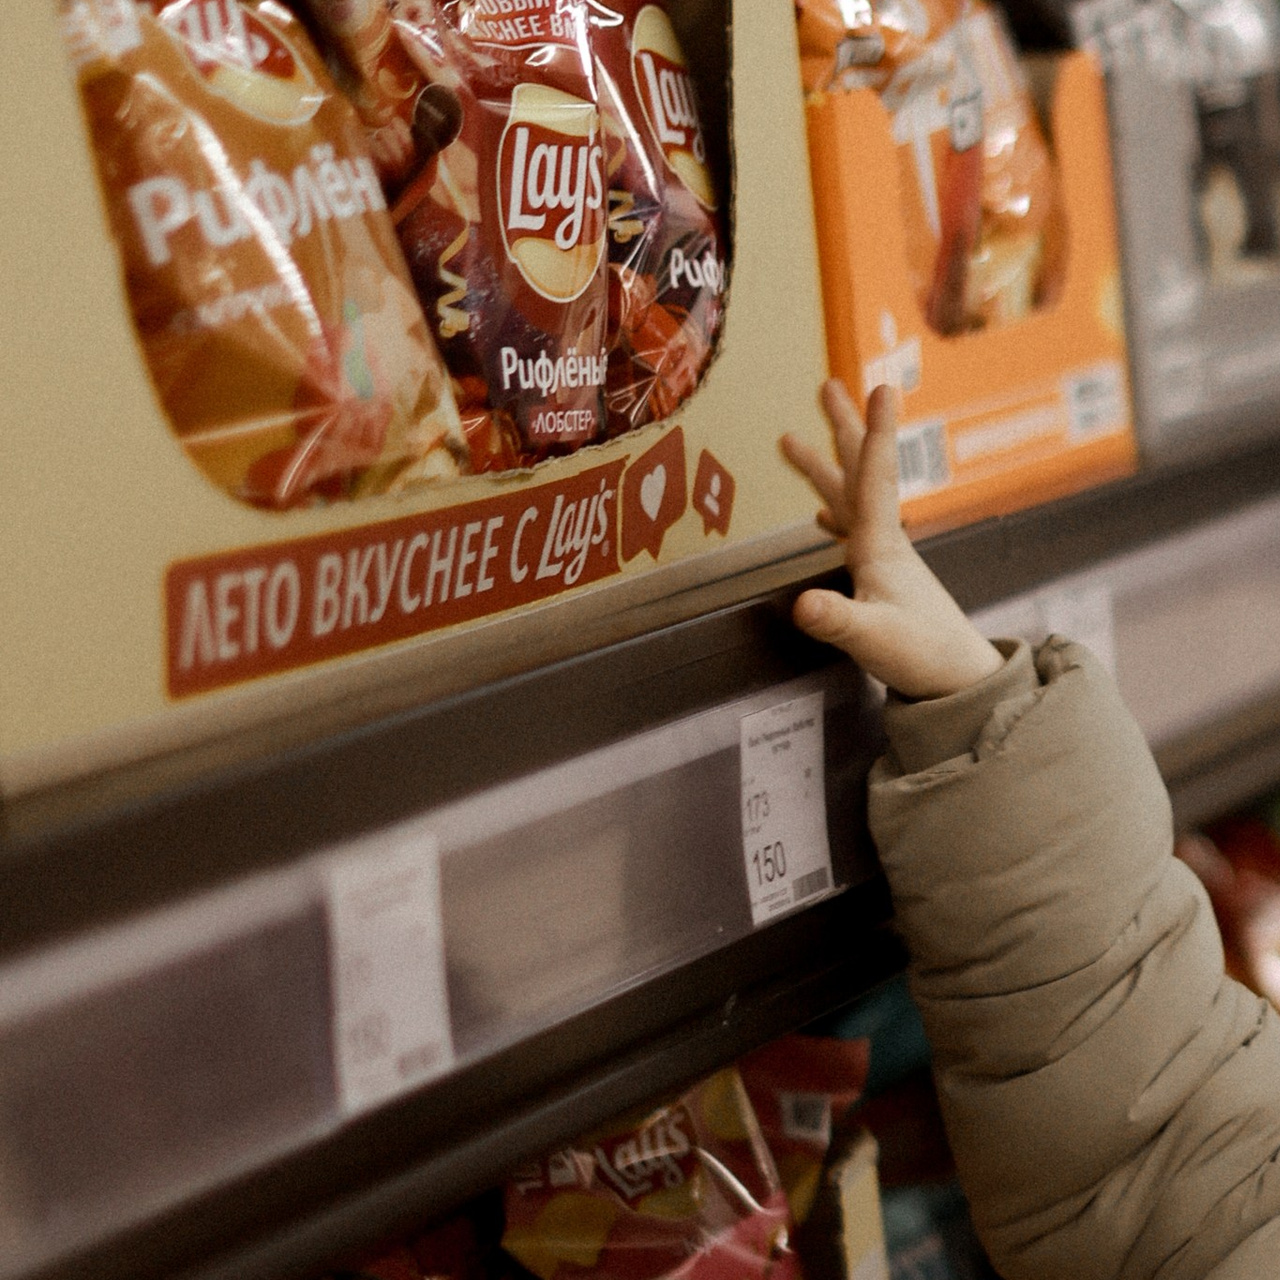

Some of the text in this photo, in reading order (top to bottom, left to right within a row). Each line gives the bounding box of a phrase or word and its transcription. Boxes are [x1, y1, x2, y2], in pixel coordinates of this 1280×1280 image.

[128, 144, 388, 269] Рифлён
[508, 126, 603, 251] Lay's
[179, 558, 300, 672] ЛЕТО
[312, 515, 506, 638] ВКУСНЕЕ
[535, 477, 616, 586] Lay's
[753, 841, 787, 886] 150
